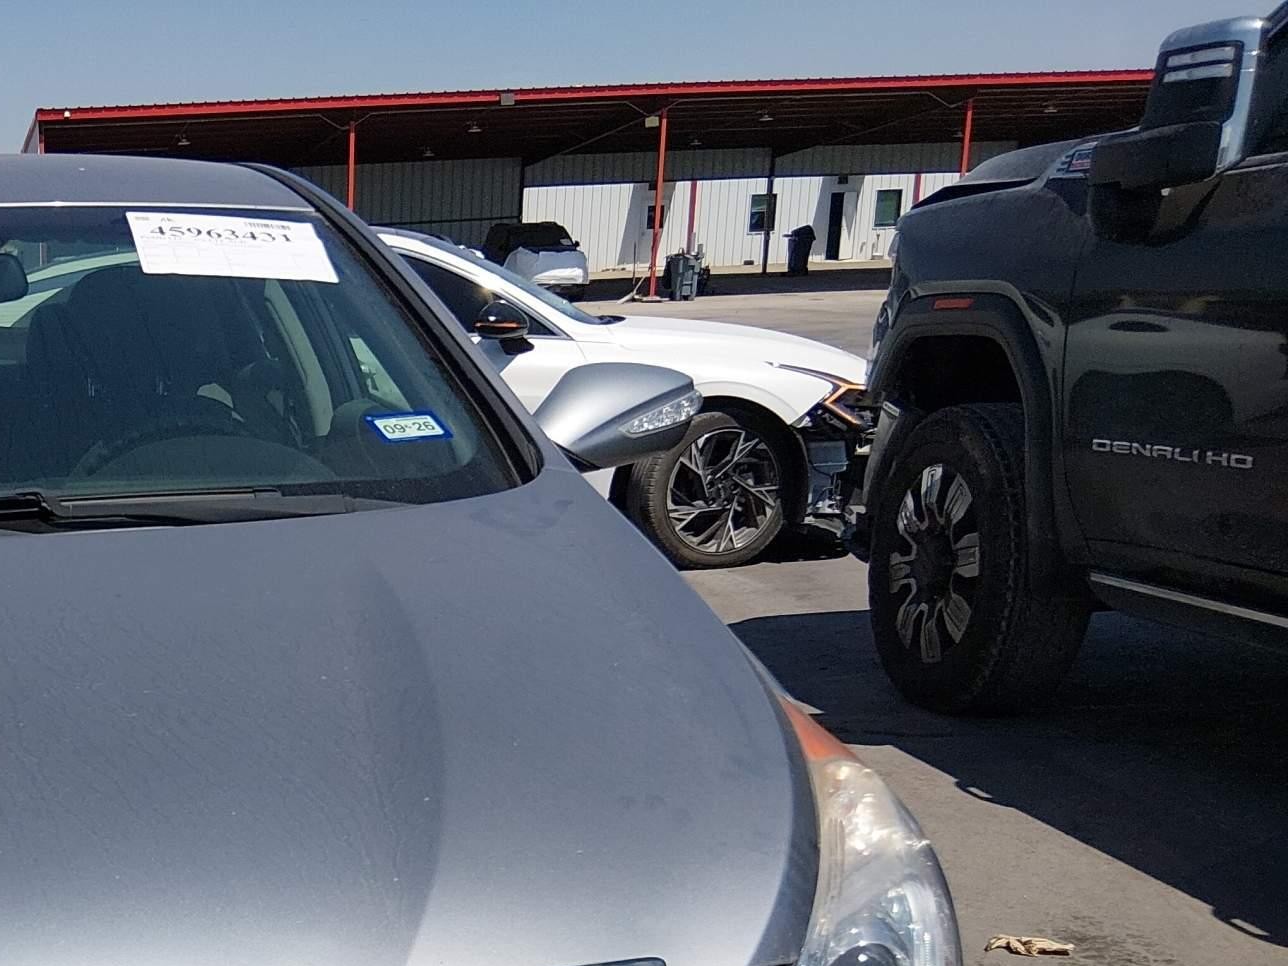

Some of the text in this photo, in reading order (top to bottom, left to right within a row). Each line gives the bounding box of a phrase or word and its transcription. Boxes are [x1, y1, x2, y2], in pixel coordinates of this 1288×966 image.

[150, 225, 293, 243] 45963431
[1091, 438, 1254, 469] DENALI HD
